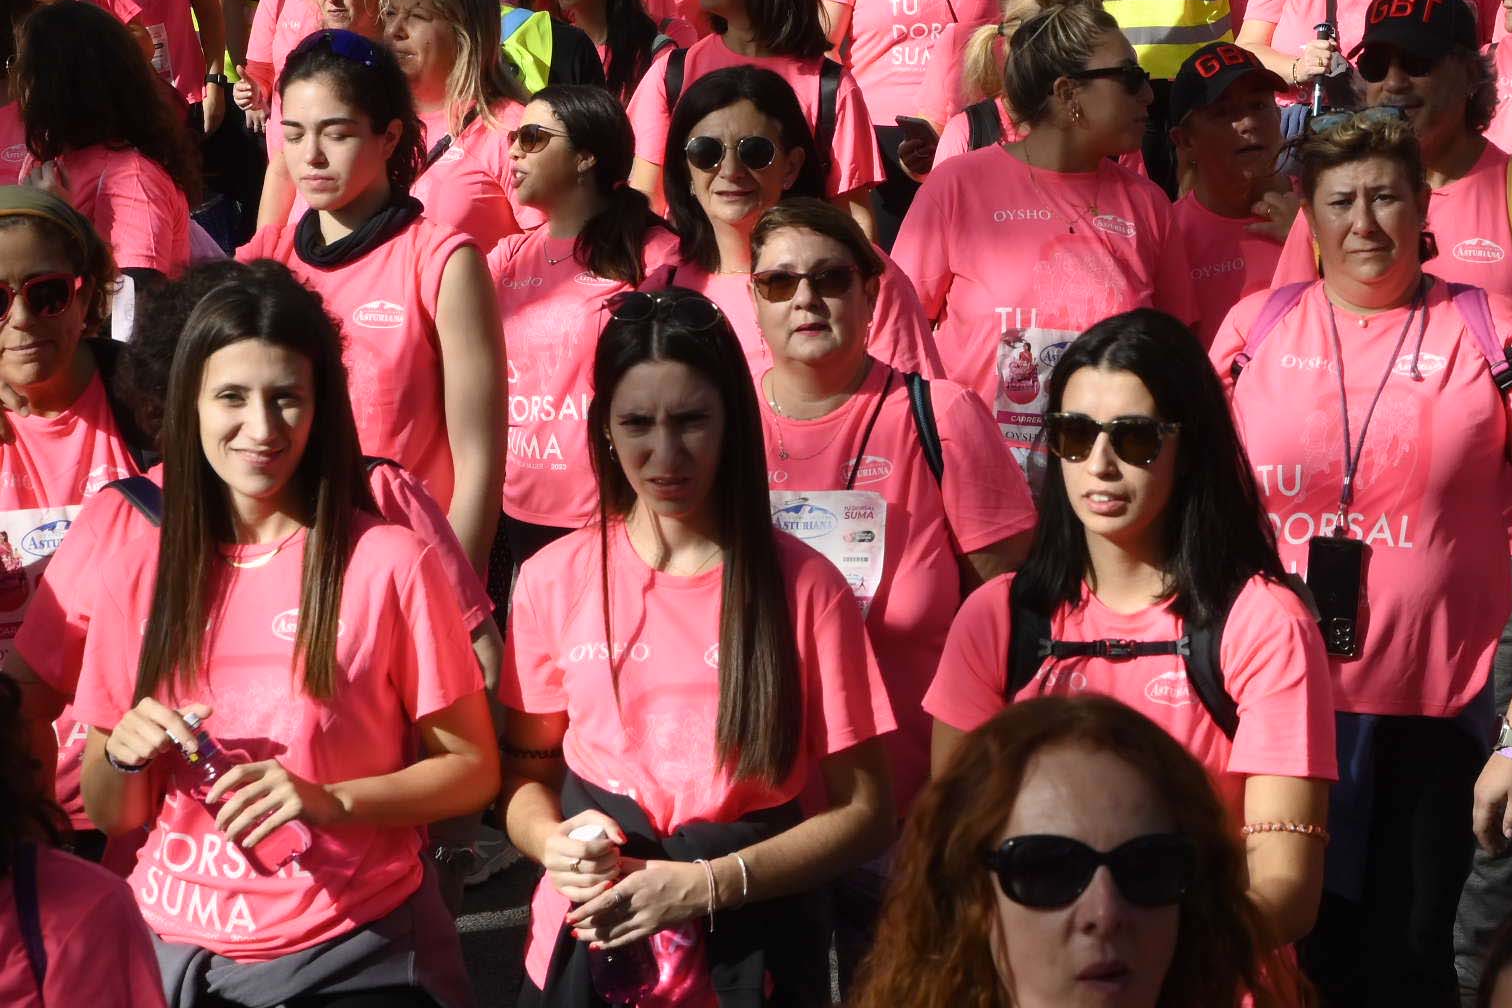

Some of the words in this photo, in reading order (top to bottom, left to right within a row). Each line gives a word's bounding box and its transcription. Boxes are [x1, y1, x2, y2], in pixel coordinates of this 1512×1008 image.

[892, 23, 943, 41] DOR
[1194, 44, 1247, 79] GB
[993, 208, 1052, 223] OYSHO
[1458, 247, 1502, 259] ASTURIANA
[1255, 464, 1303, 497] TU
[844, 511, 875, 520] SUMA
[141, 864, 257, 935] SUMA
